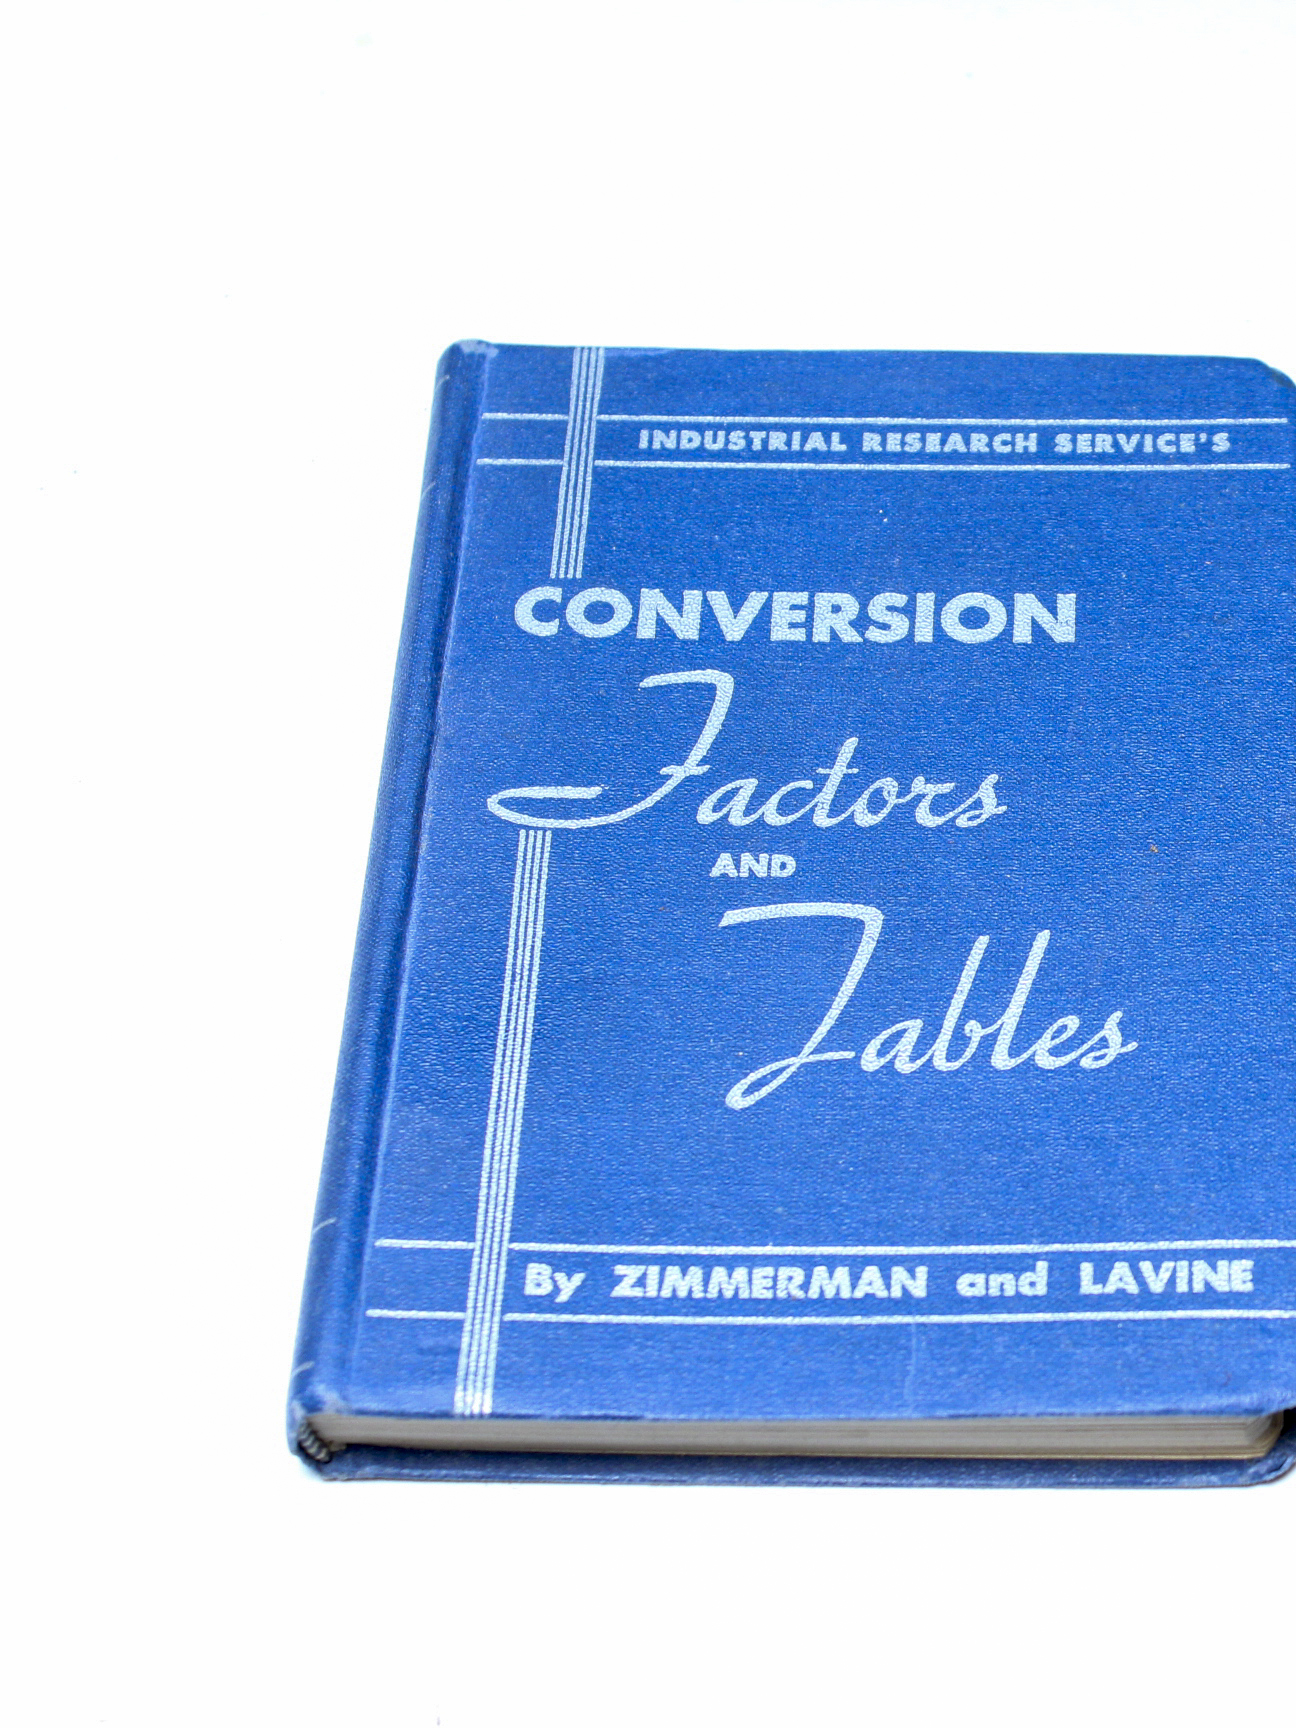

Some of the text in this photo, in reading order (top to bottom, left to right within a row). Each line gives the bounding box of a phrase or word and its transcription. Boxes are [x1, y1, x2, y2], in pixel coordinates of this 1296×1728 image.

[639, 428, 1232, 454] INDUSTRIAL RESEARCH SERVICE'S
[514, 586, 1077, 644] CONVERSION
[487, 668, 1009, 829] Factors
[709, 852, 796, 878] AND
[718, 900, 1139, 1112] Tables
[523, 1260, 1255, 1304] By ZIMMERMAN and LAVINE
